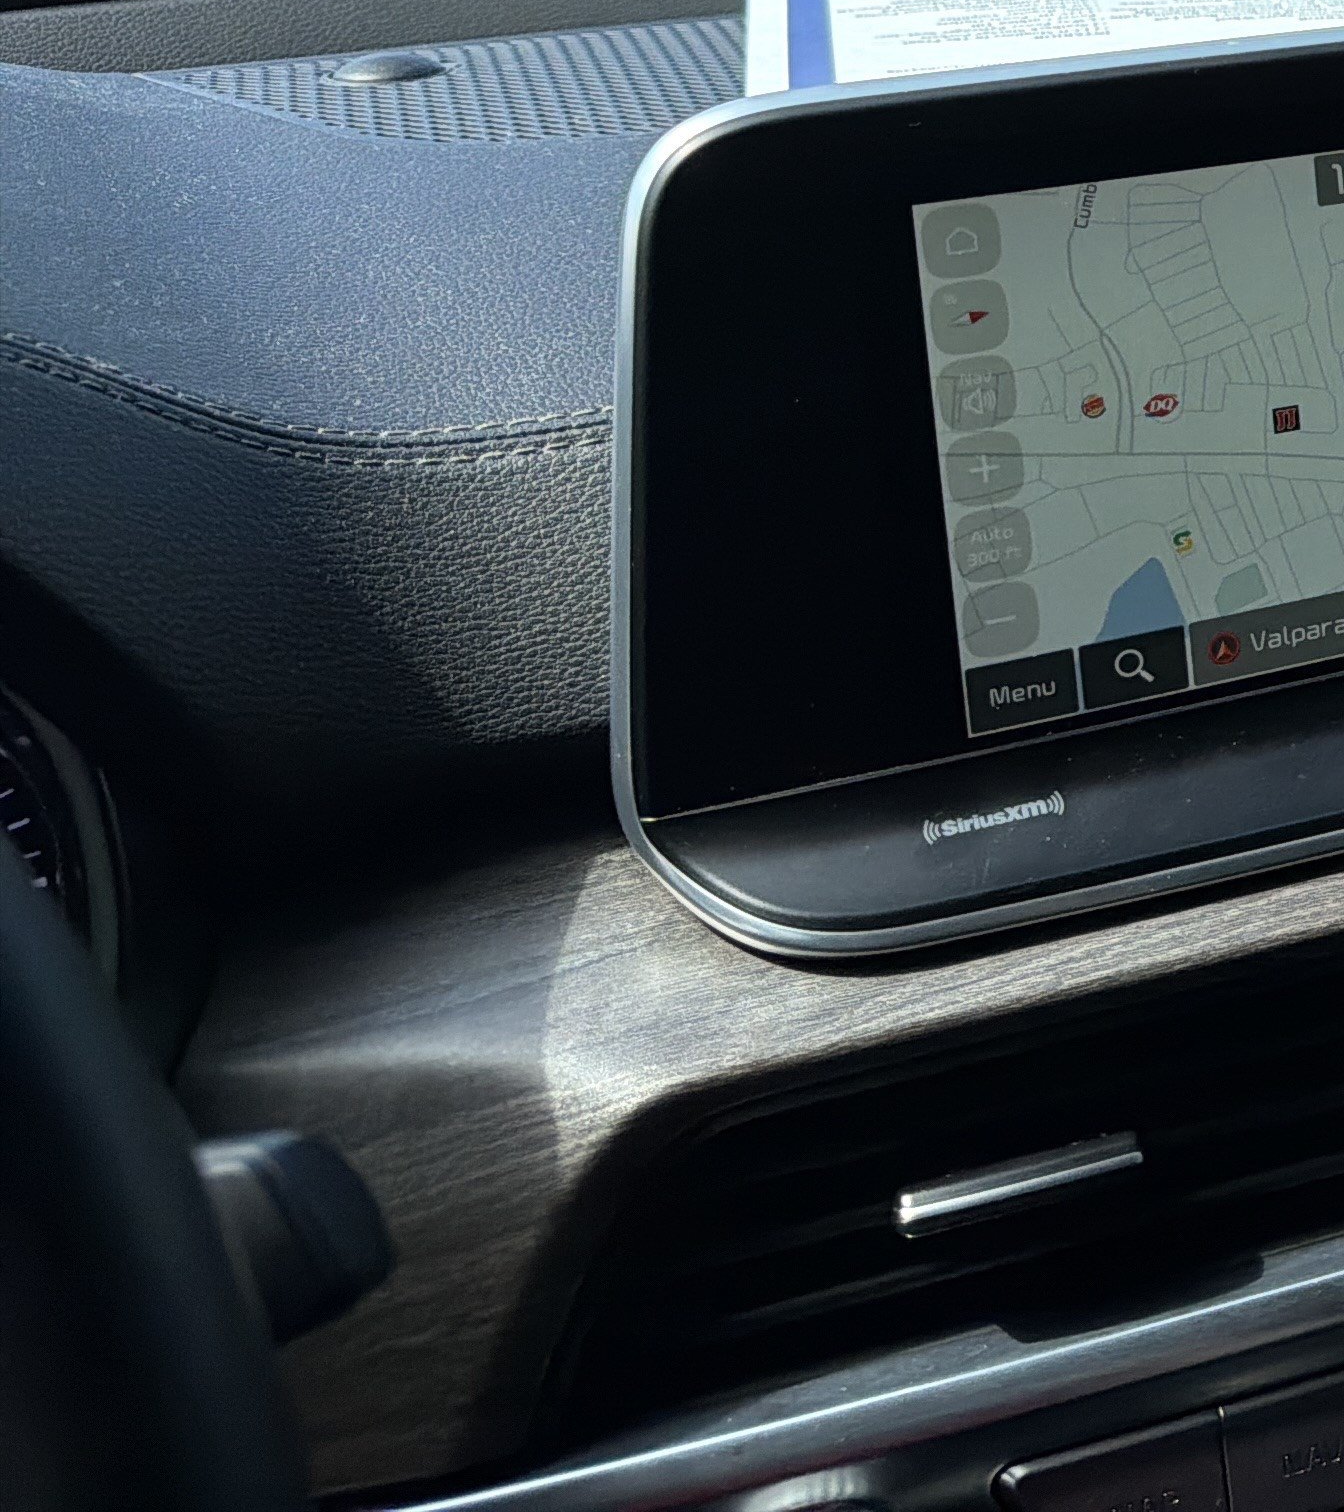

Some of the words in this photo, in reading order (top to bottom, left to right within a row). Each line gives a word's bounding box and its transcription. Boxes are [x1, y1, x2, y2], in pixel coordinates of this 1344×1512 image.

[1149, 398, 1174, 413] DQ
[970, 525, 1015, 543] Auto
[989, 679, 1058, 708] Menu
